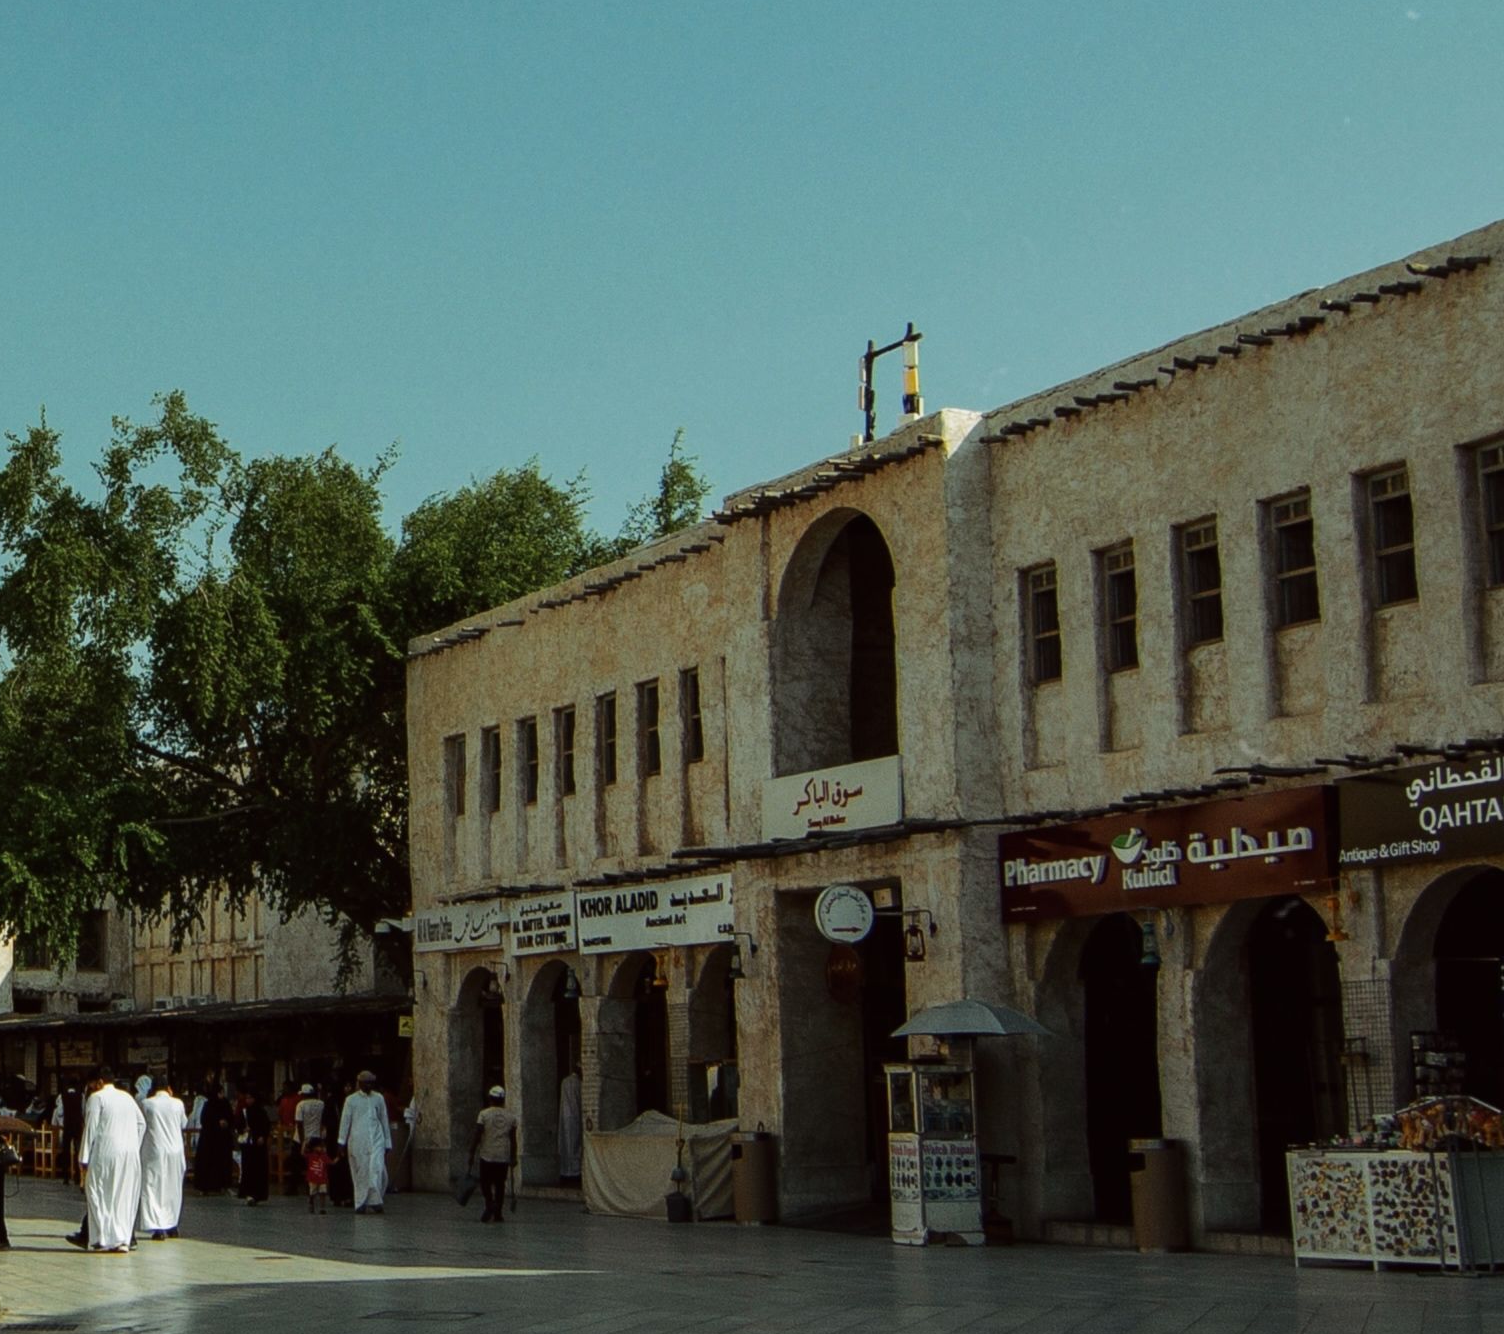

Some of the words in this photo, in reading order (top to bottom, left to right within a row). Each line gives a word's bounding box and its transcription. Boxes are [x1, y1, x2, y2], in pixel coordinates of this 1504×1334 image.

[793, 778, 830, 815] الباكر
[832, 782, 863, 808] سوق
[1186, 826, 1316, 871] صيدلية
[1338, 849, 1379, 864] Antique
[1389, 841, 1412, 855] Gift
[1412, 839, 1440, 855] Shop
[1004, 855, 1106, 887] Pharmacy
[1122, 864, 1179, 889] Kulud
[580, 896, 613, 918] KHOR
[615, 890, 658, 915] ALADID
